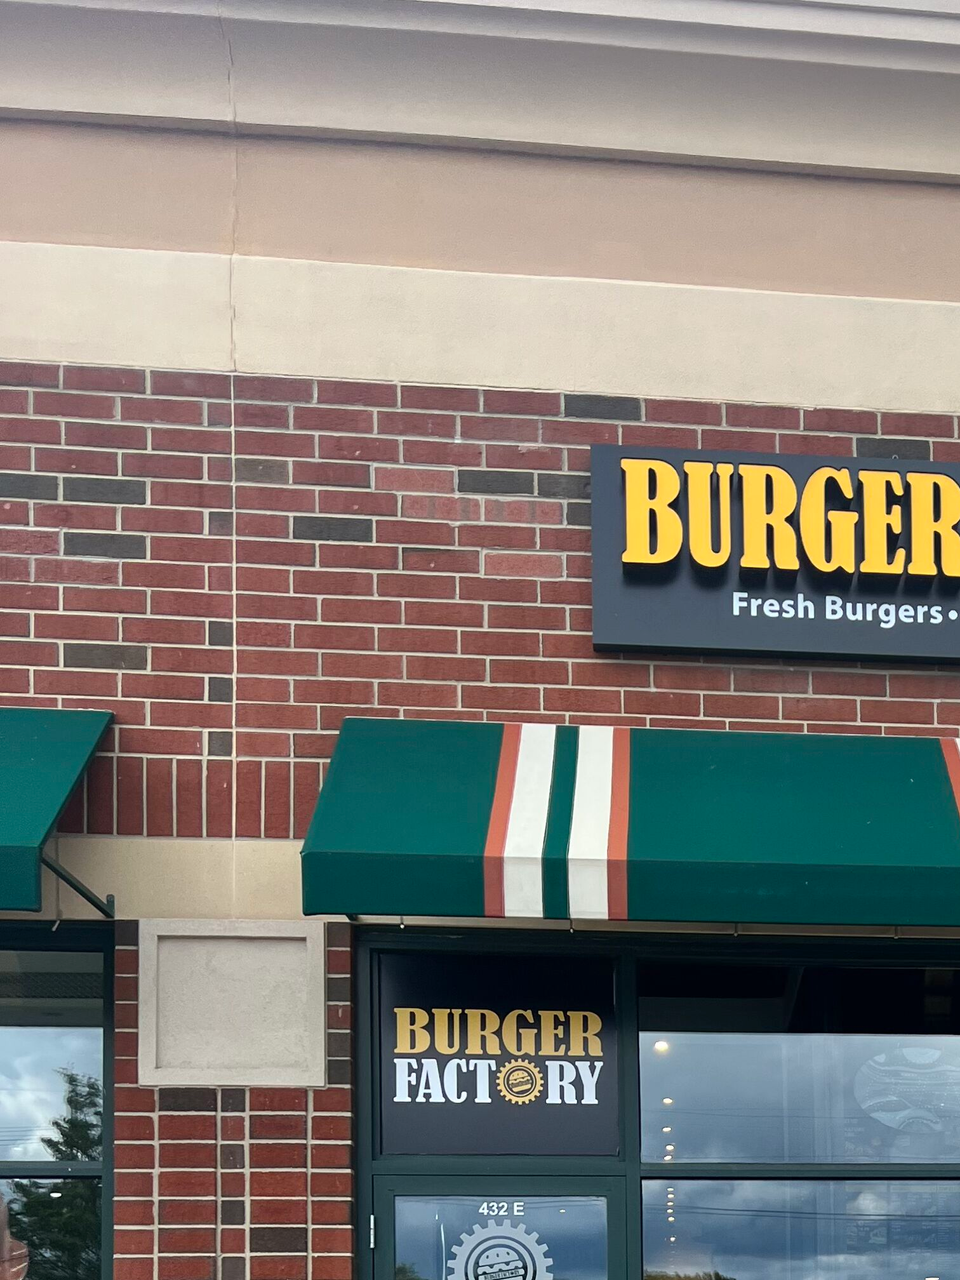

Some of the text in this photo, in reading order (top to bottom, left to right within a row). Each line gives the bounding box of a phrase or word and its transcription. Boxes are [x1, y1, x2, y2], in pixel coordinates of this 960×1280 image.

[732, 592, 815, 620] Fresh
[824, 596, 943, 627] Burgers
[393, 1007, 604, 1056] BURGER
[479, 1202, 524, 1216] 432 E
